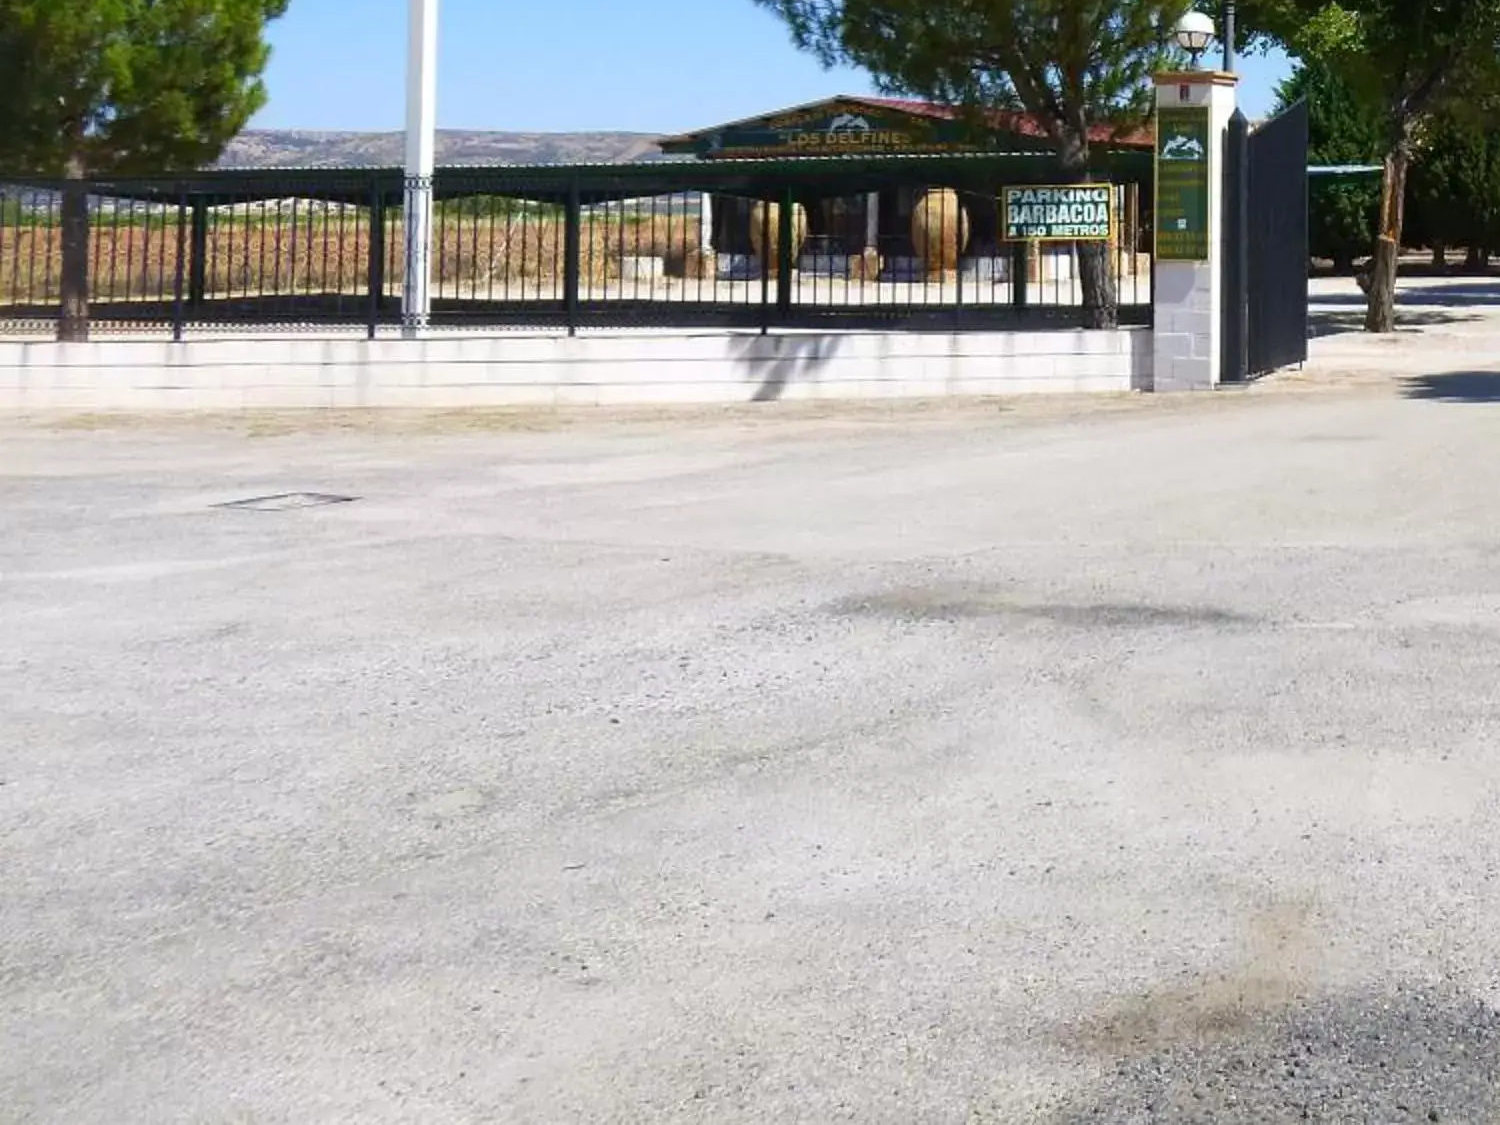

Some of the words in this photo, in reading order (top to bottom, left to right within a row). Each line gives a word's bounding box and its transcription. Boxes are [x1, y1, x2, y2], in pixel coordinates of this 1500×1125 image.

[1007, 188, 1109, 203] PARKING
[1007, 203, 1109, 224] BARBACOA
[1008, 225, 1017, 236] A
[1023, 225, 1047, 236] 150
[1051, 224, 1109, 236] METROS
